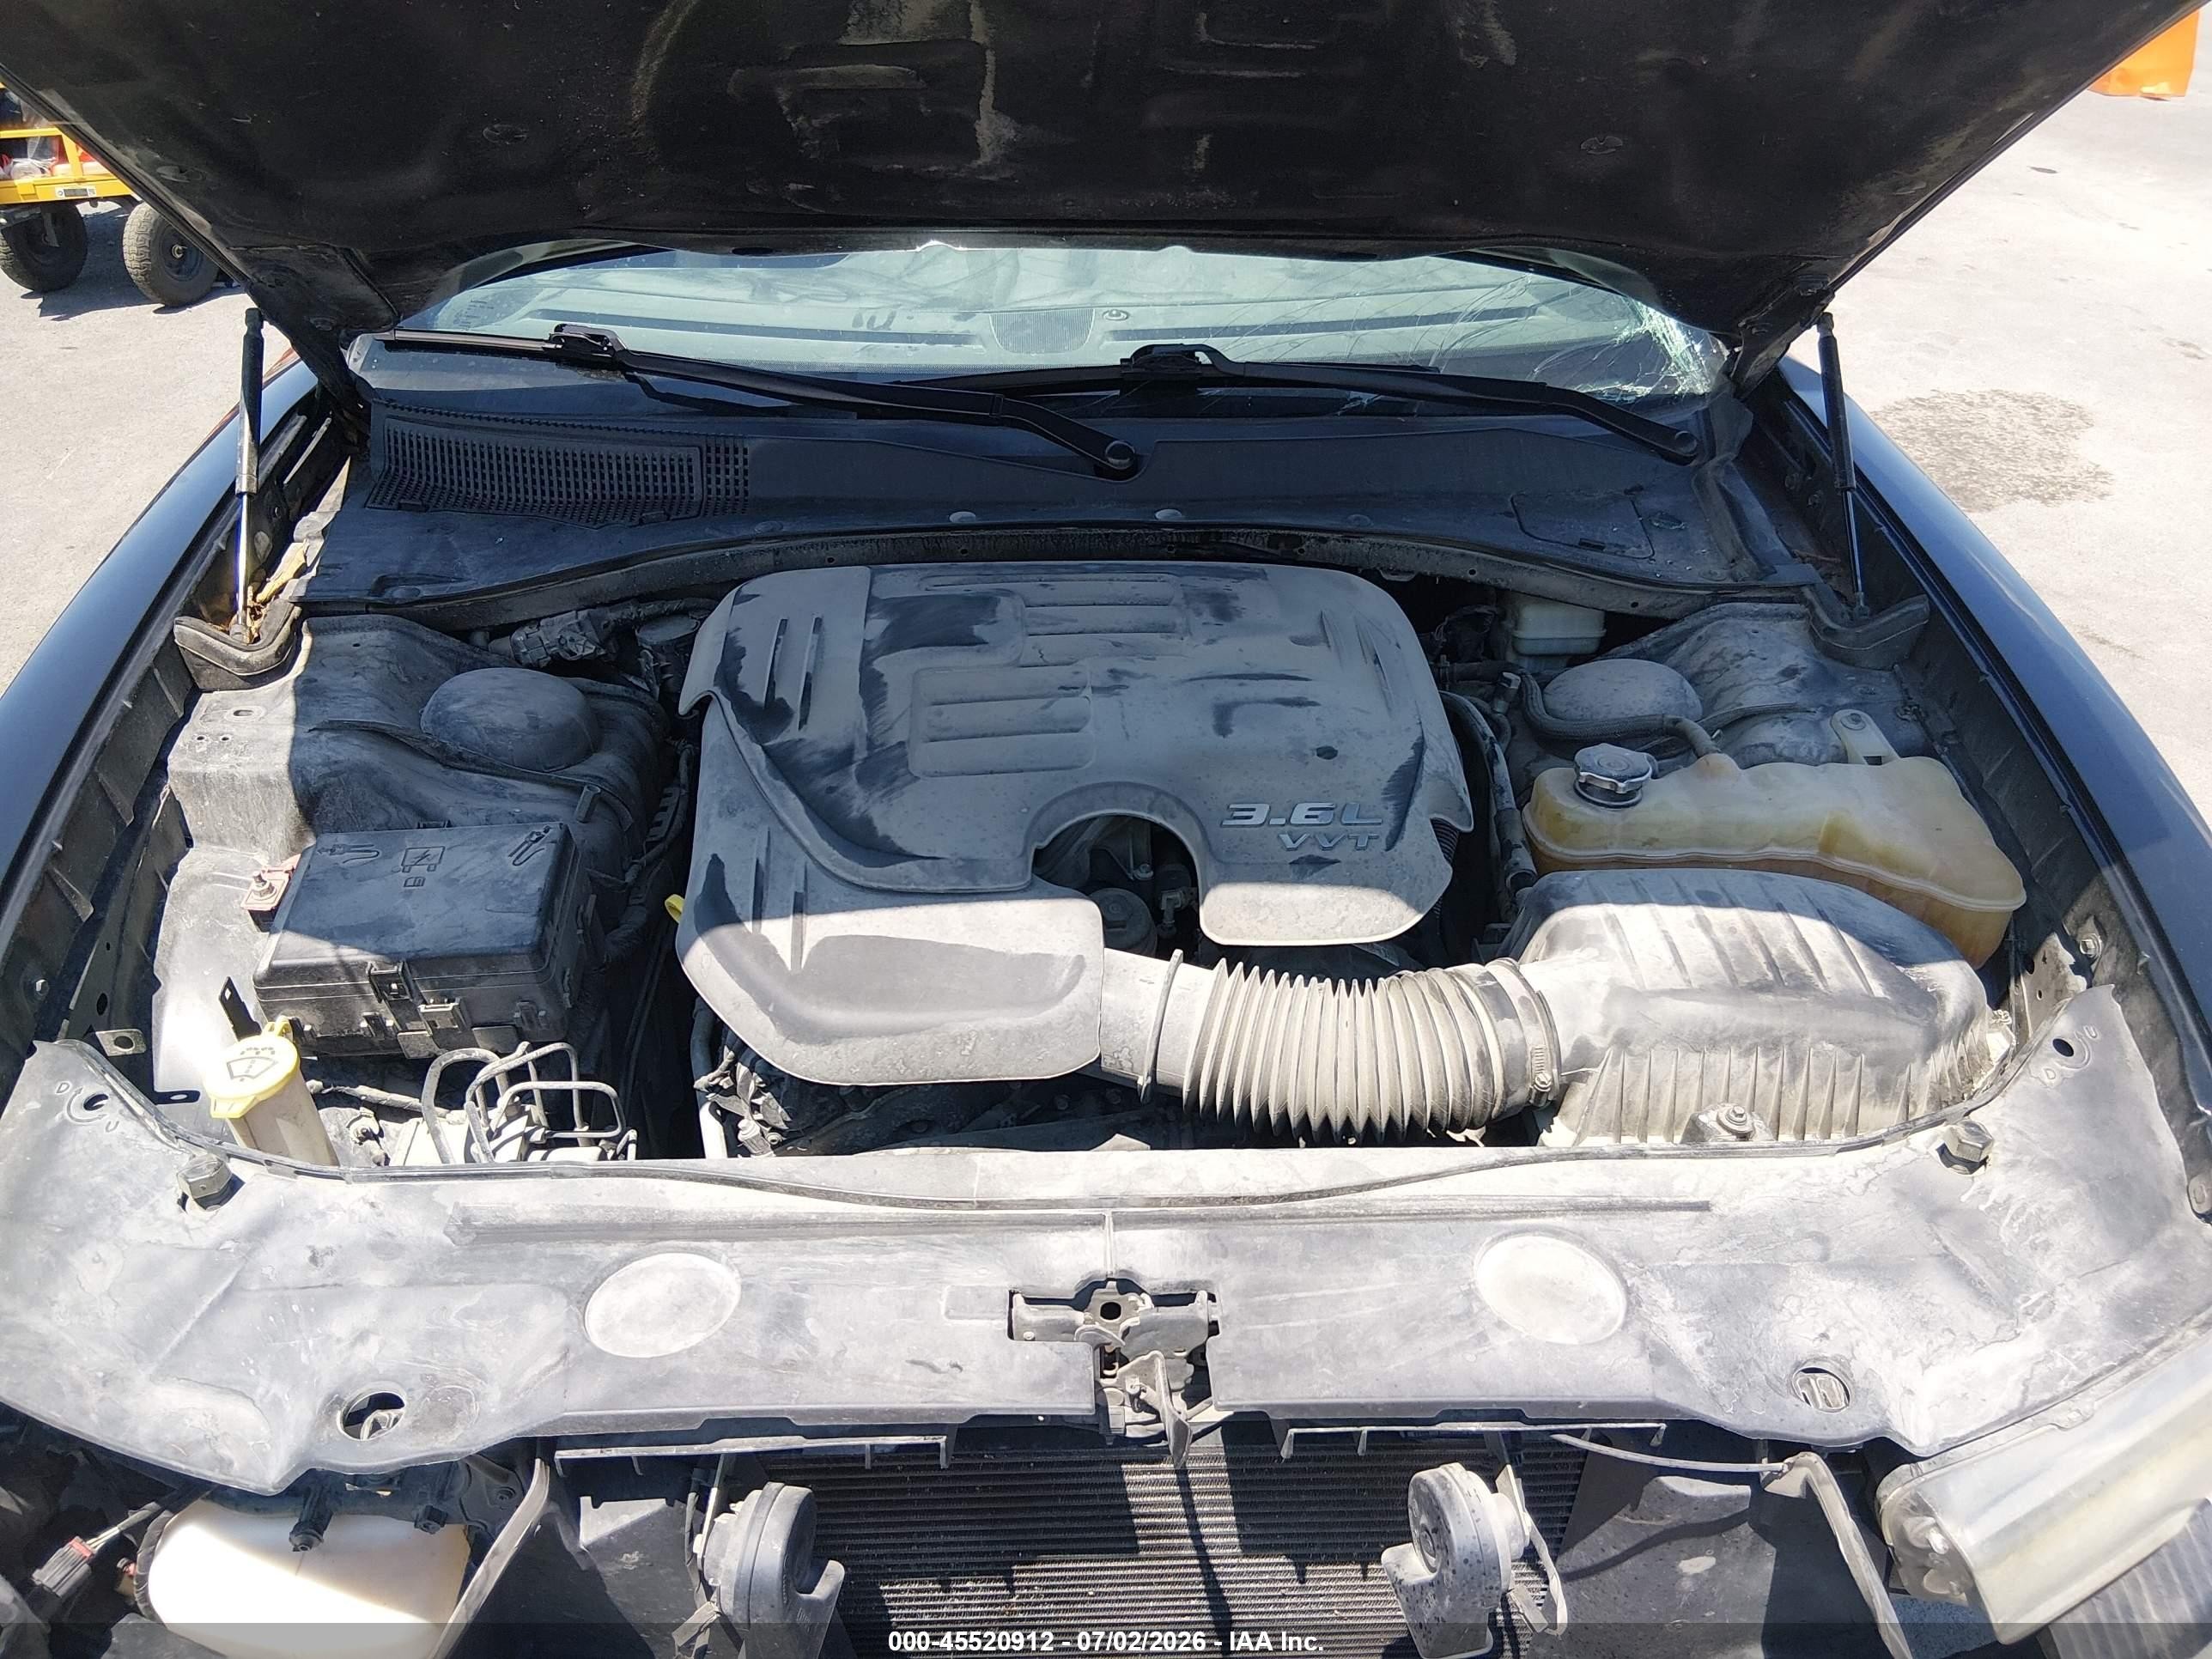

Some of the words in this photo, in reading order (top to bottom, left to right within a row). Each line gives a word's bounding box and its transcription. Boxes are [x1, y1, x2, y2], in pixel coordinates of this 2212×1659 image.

[1221, 802, 1382, 827] 3.6L
[1278, 833, 1380, 851] VVT
[2043, 1067, 2057, 1080] D
[55, 1081, 71, 1094] D
[105, 1120, 120, 1133] U
